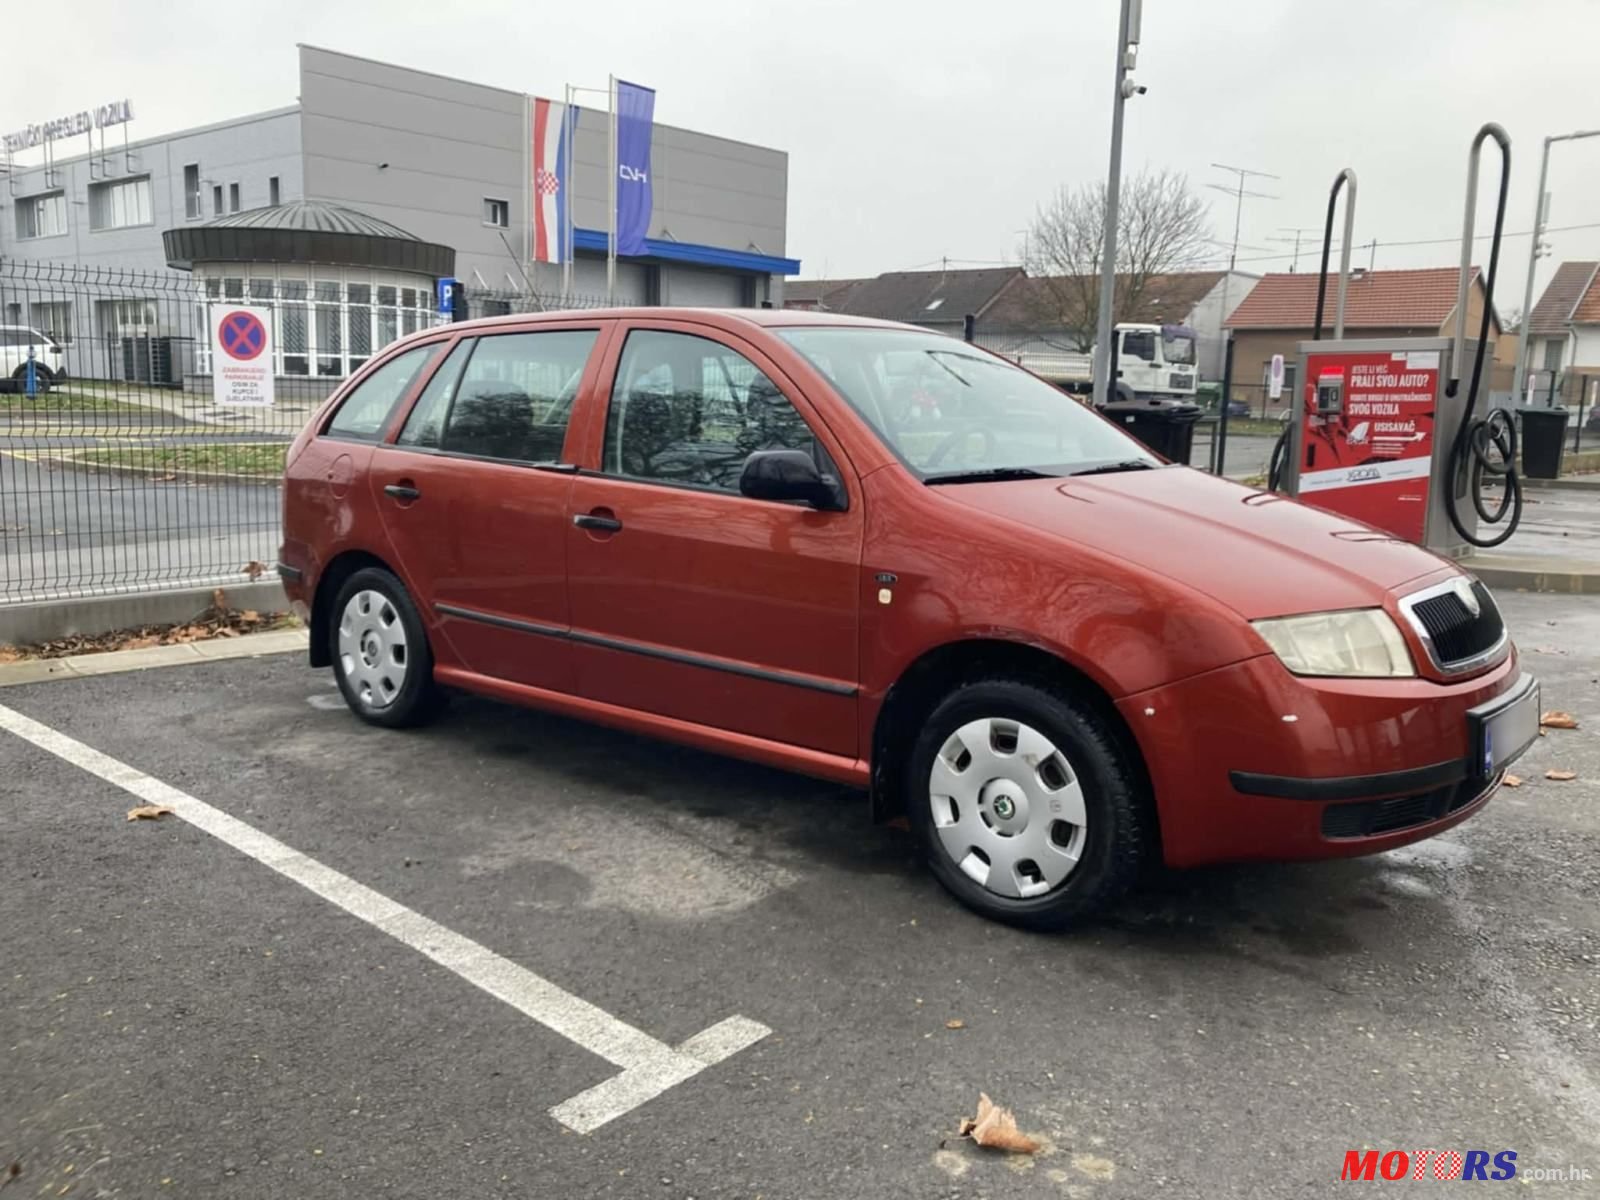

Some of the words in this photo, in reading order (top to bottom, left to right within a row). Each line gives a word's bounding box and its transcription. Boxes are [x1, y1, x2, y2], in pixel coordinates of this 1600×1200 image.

[44, 111, 92, 141] PREGLED
[93, 98, 135, 129] VOZILA
[620, 164, 647, 184] CVH
[443, 285, 452, 307] P
[1351, 375, 1375, 388] PRALI
[1376, 375, 1398, 388] SVOJ
[1399, 374, 1430, 387] AUTO?
[1348, 403, 1370, 415] SVOG
[1371, 403, 1400, 415] VOZILA
[1374, 420, 1416, 432] USISAVAČ
